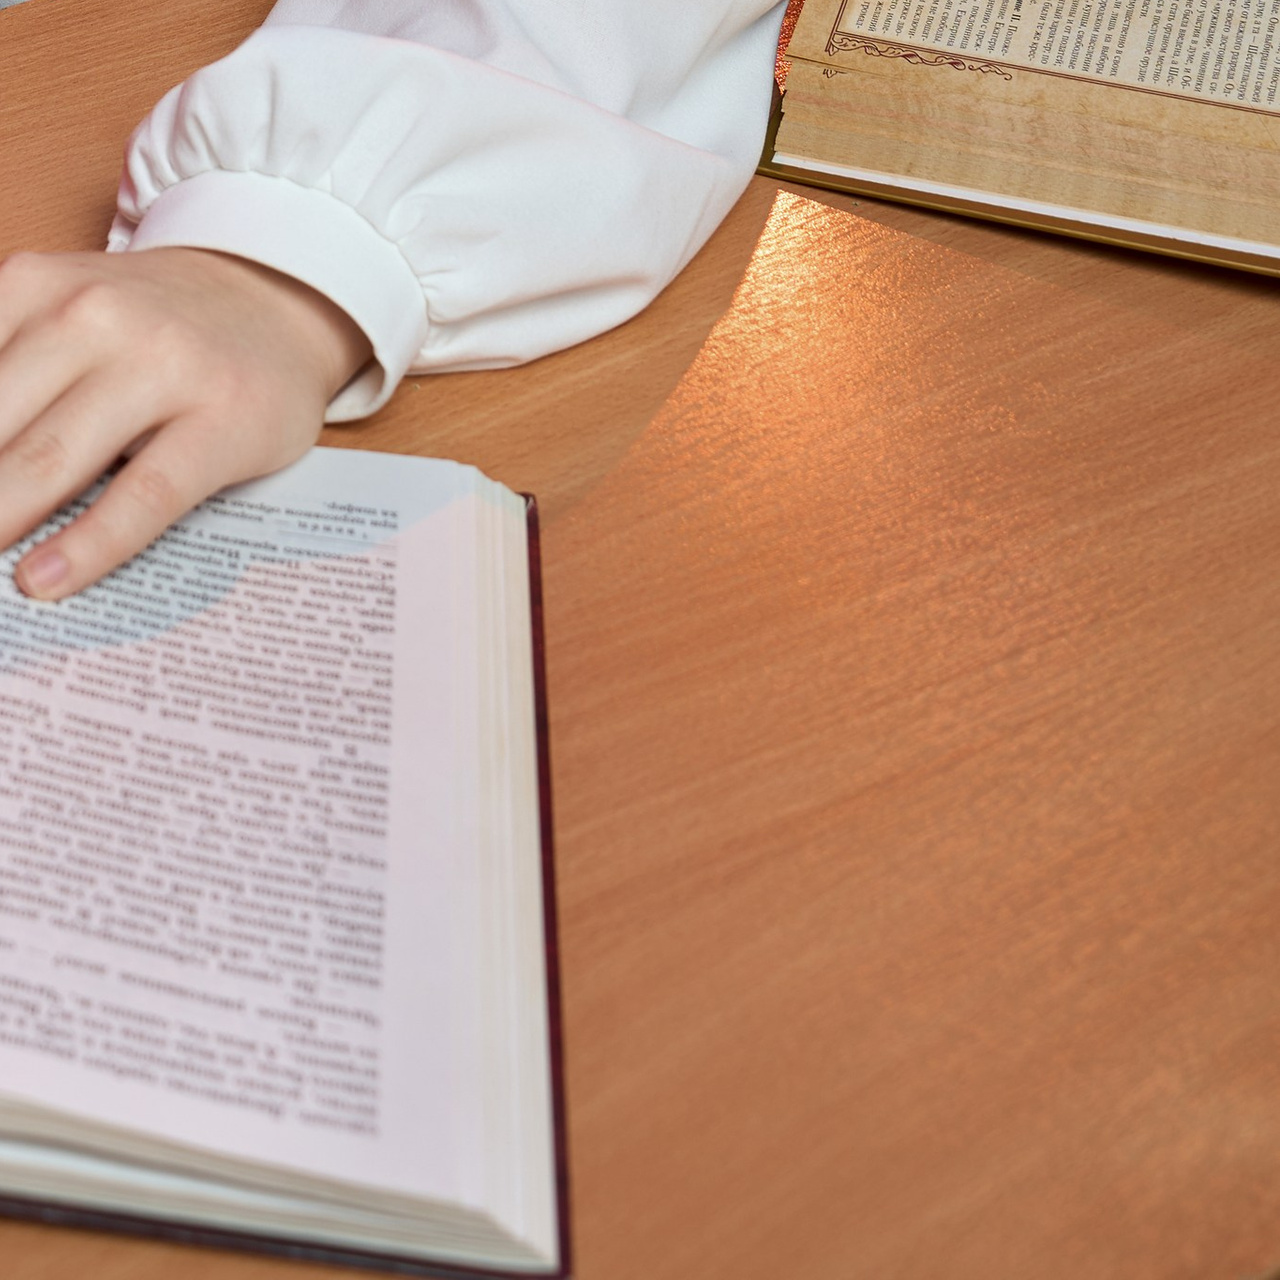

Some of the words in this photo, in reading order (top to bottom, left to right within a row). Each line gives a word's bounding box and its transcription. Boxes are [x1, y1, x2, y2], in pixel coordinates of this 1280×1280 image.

[868, 0, 885, 33] желаний
[946, 9, 968, 47] Екатерина
[1167, 2, 1179, 23] стать
[1159, 23, 1174, 54] органом
[1233, 20, 1248, 51] каждого
[1081, 33, 1099, 73] населении
[1109, 55, 1122, 77] своих
